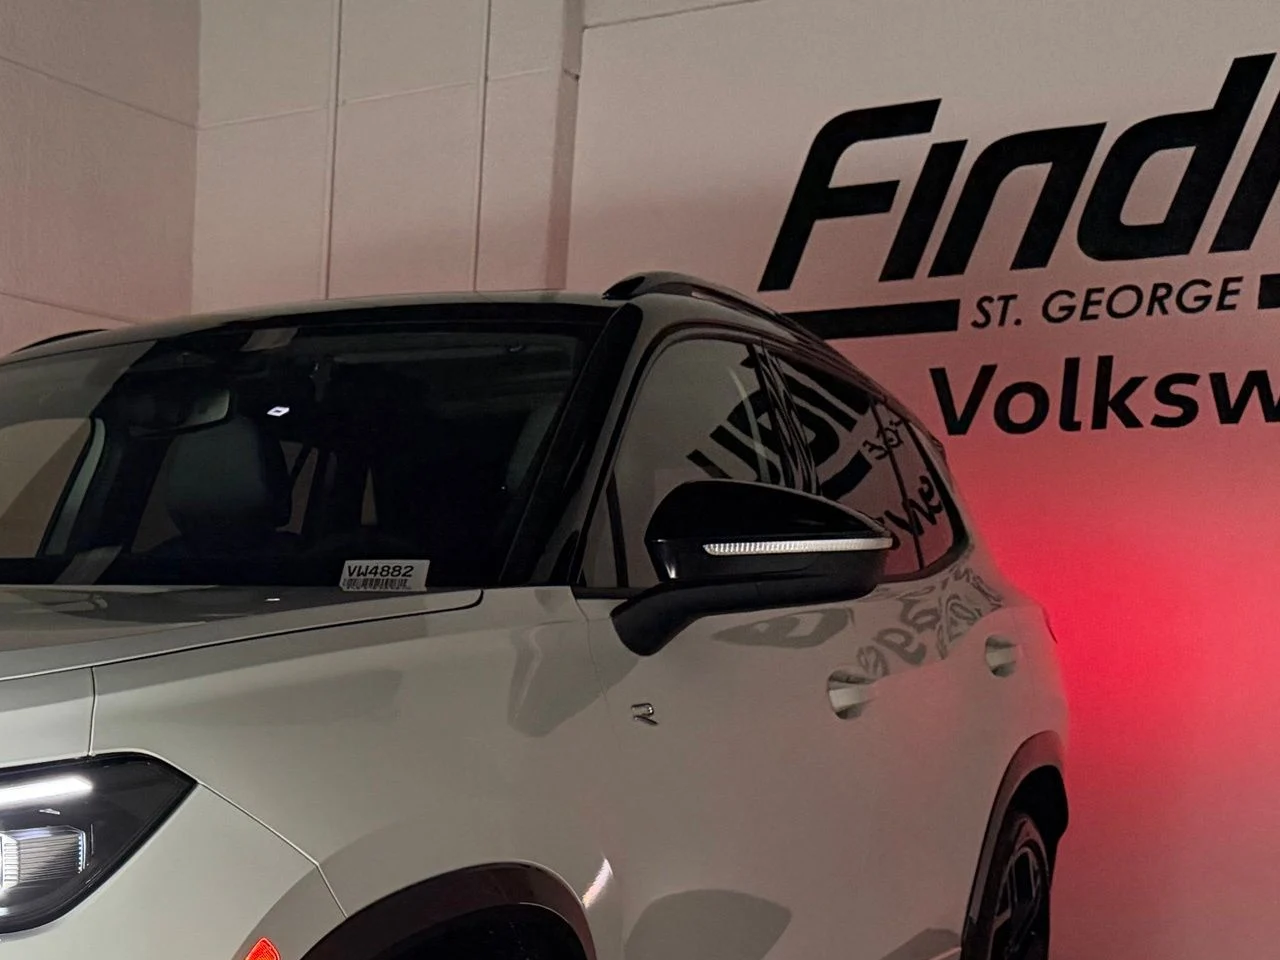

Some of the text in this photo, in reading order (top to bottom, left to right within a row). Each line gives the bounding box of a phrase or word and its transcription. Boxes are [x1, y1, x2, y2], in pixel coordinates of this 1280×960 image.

[970, 276, 1245, 329] ST. GEORGE
[347, 565, 415, 578] VW4882
